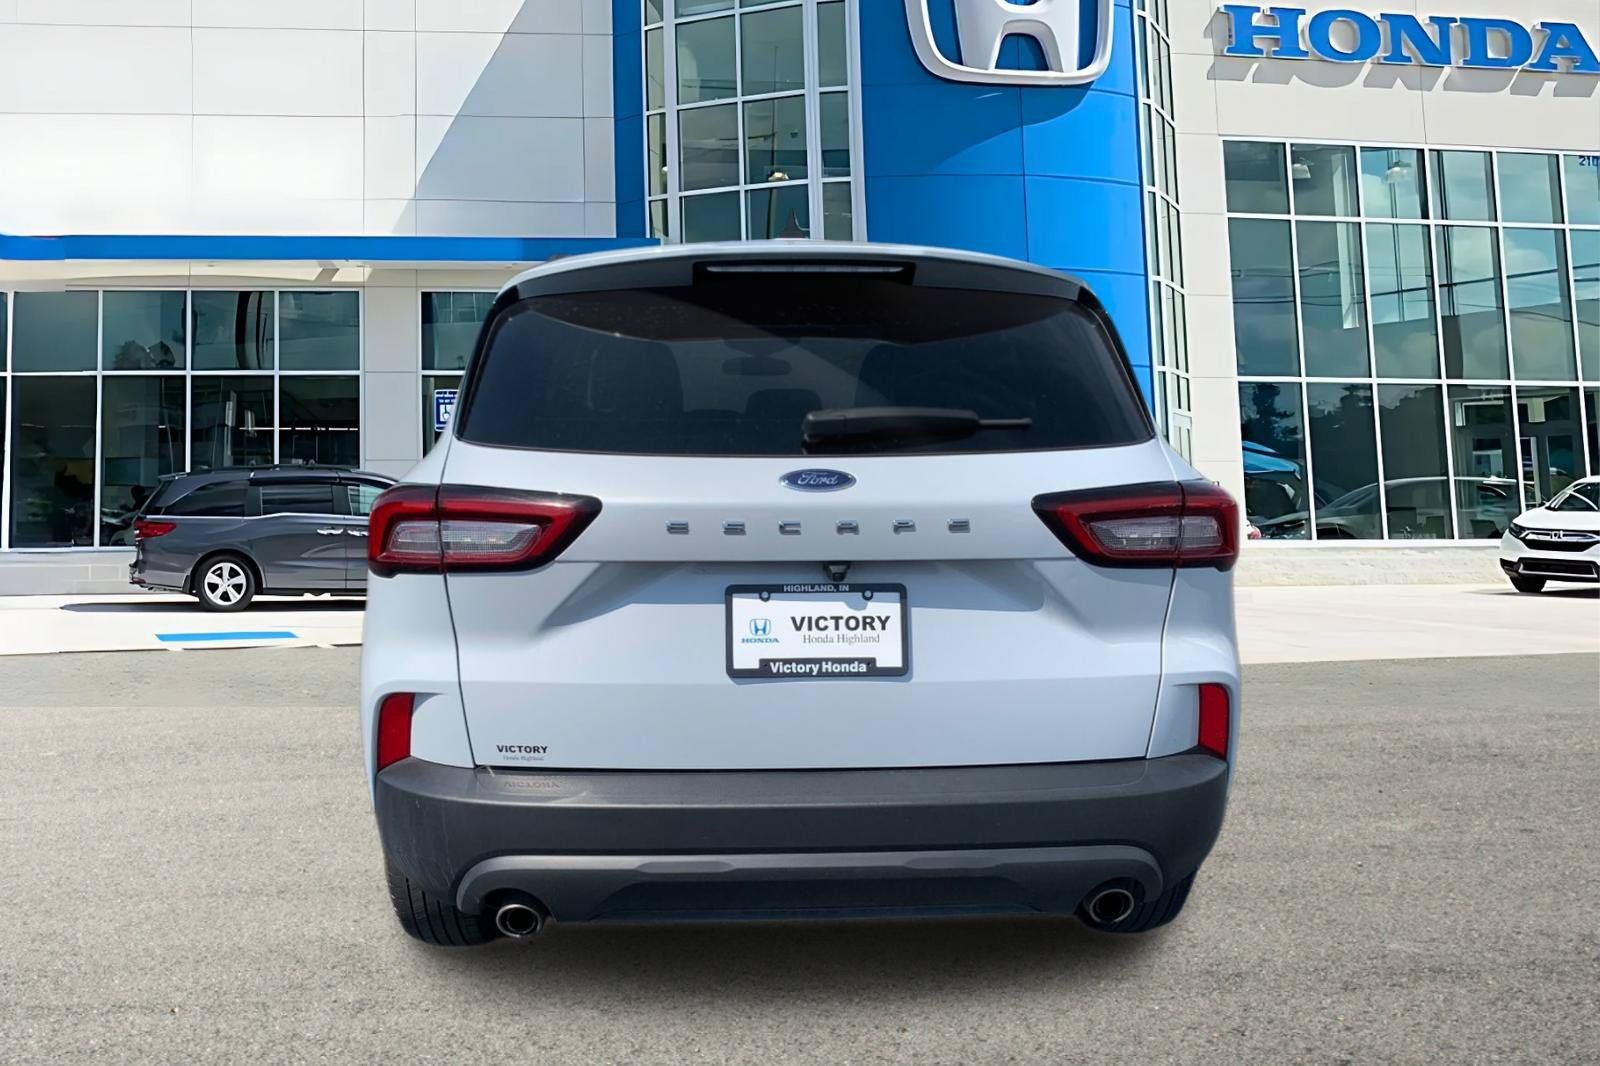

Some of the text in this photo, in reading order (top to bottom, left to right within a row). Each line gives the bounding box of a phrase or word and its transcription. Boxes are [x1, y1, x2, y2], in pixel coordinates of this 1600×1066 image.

[1223, 4, 1600, 74] HONDA
[666, 518, 971, 535] ESCAPE
[791, 616, 890, 631] VICTORY
[803, 633, 880, 645] Honda Highland
[770, 661, 866, 674] Victory Honda
[497, 745, 548, 753] VICTORY
